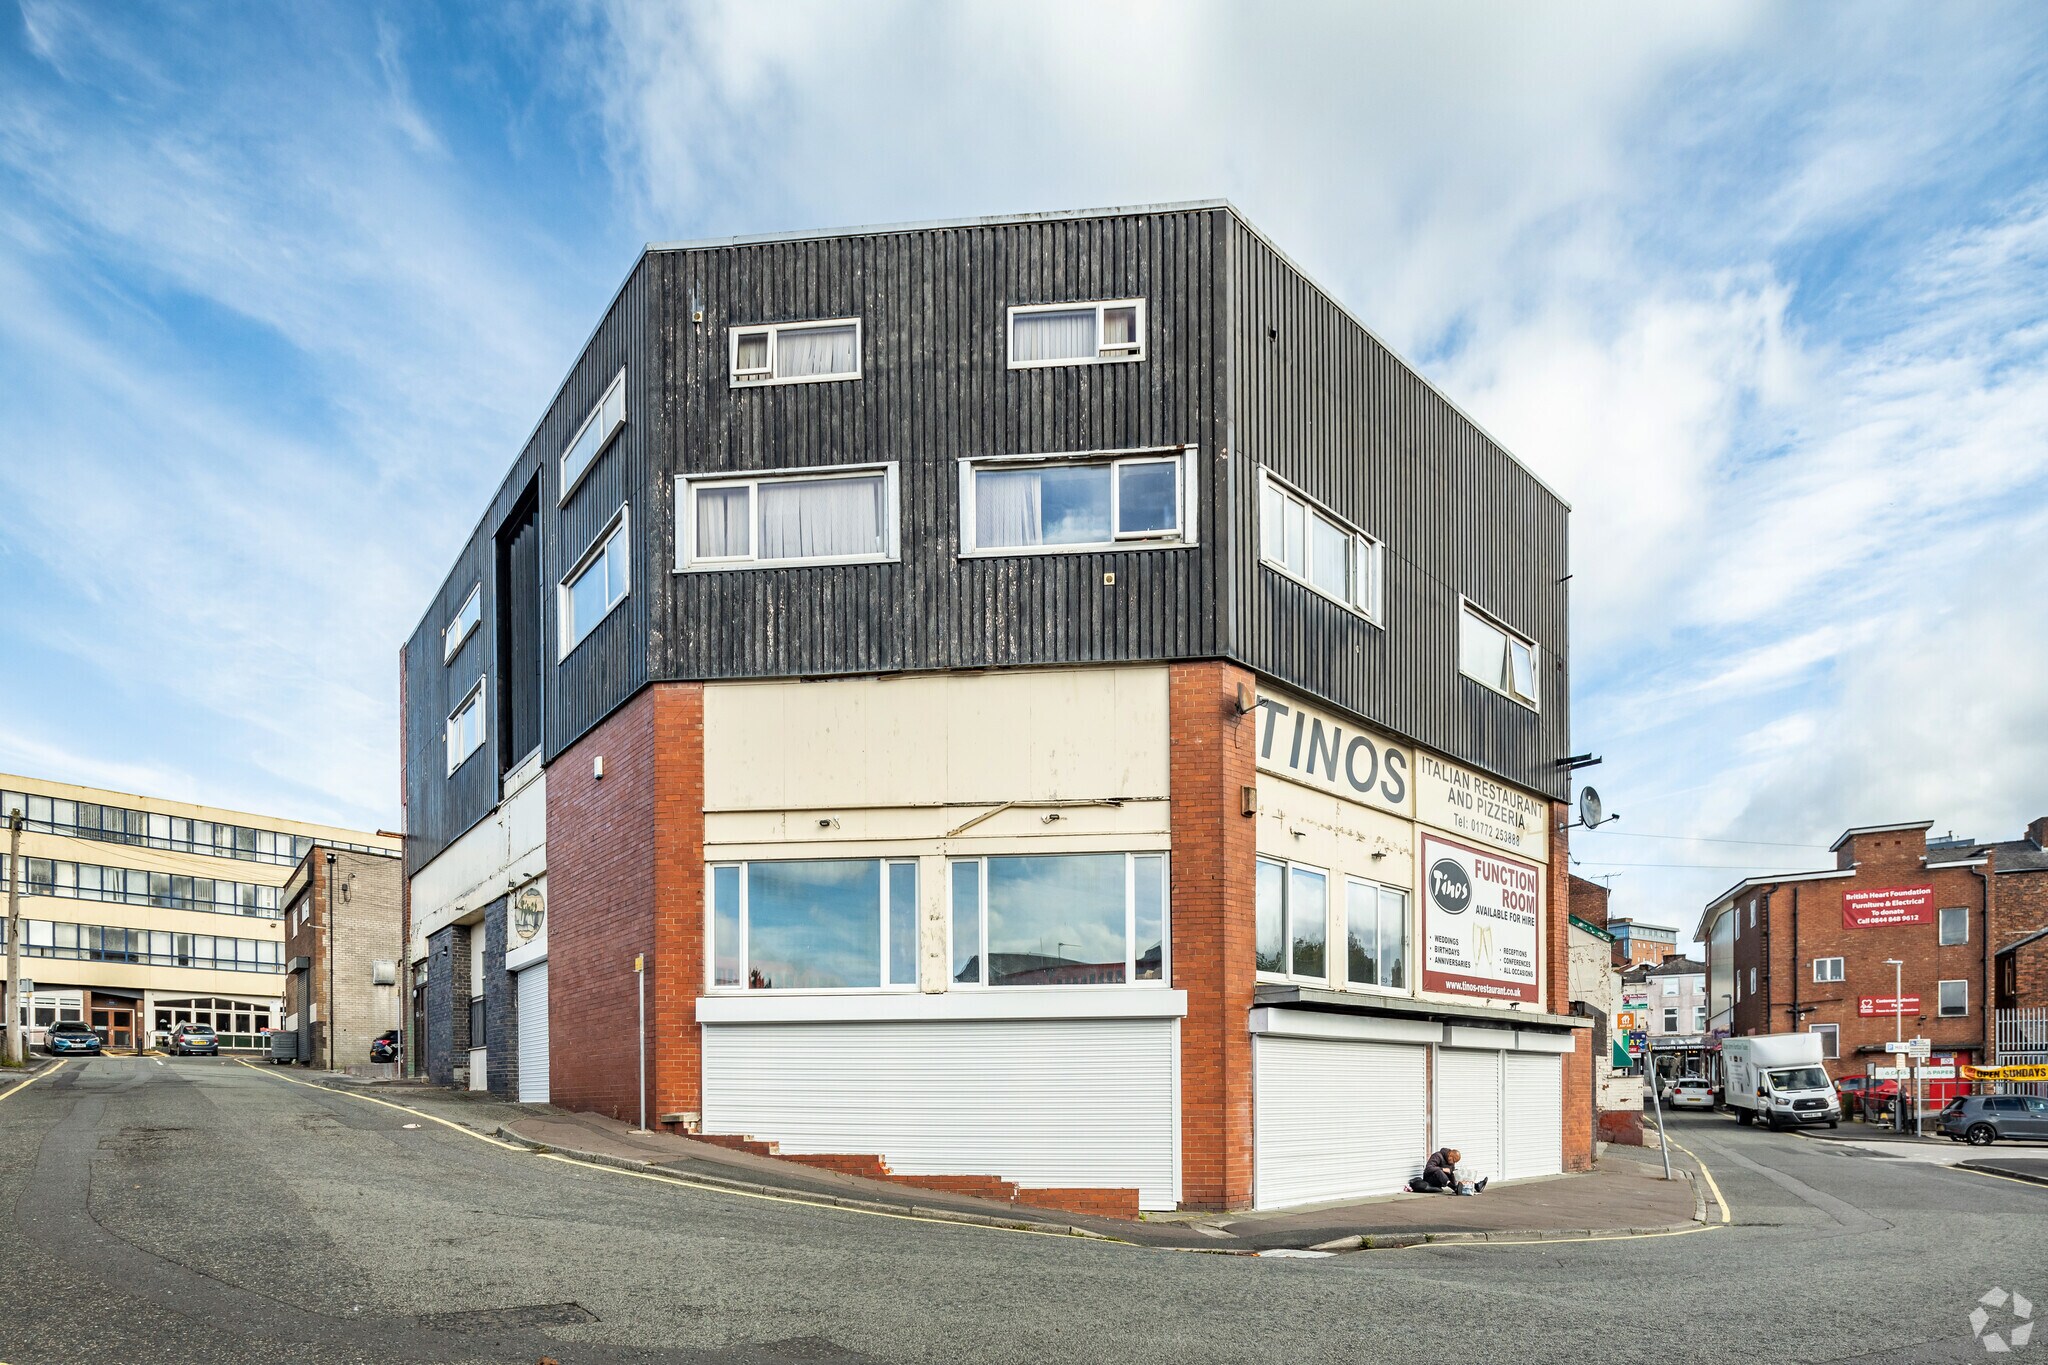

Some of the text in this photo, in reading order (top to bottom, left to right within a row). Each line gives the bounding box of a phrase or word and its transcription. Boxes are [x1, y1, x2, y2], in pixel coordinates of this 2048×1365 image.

[1256, 695, 1407, 804] TINOS
[1422, 756, 1543, 818] ITALIAN RESTAURANT
[1448, 787, 1525, 830] AND PIZZERIA
[1454, 812, 1520, 847] Tel: 01772 253888
[1433, 869, 1468, 900] Tinos
[1475, 859, 1534, 893] FUNCTION
[1502, 888, 1534, 914] ROOM
[1846, 888, 1931, 900] British Heart Foundation
[1852, 901, 1884, 909] Furniture
[1892, 897, 1925, 906] Electrical
[1475, 904, 1535, 926] AVAILABLE FOR HIRE
[1434, 935, 1459, 946] WEDDINGS
[1434, 946, 1460, 956] BIRTHDAYS
[1503, 947, 1527, 957] RECEPTIONS
[1434, 956, 1471, 968] ANNIVERSARIES
[1503, 957, 1531, 968] CONFERENCES
[1445, 980, 1521, 997] www.tinos-restaurant.co.uk
[1976, 1067, 2047, 1078] OPEN SUNDAYS
